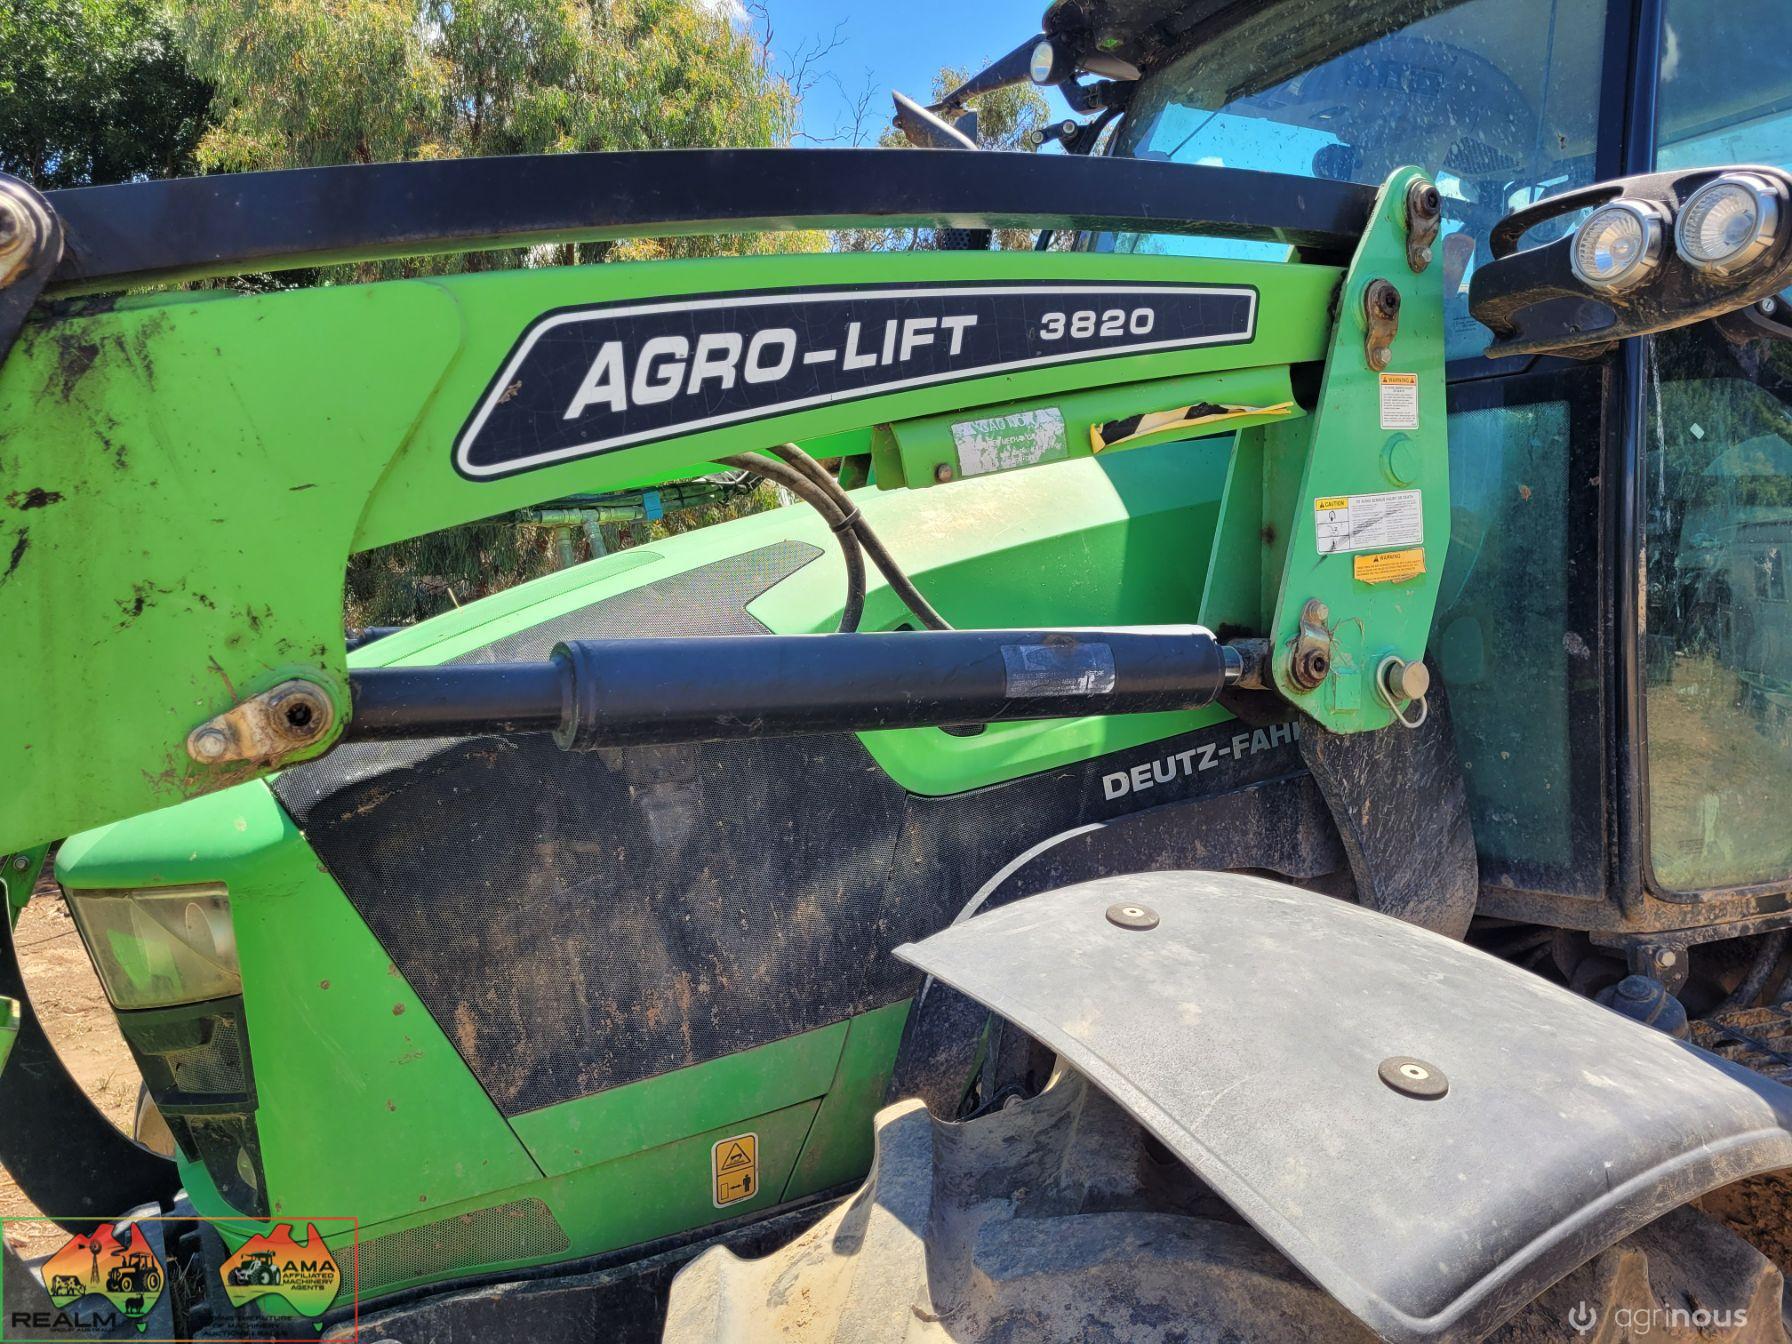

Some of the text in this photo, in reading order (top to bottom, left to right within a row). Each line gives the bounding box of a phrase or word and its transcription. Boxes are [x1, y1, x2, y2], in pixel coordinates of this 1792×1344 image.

[563, 308, 1155, 420] AGRO-LIFT 3820
[1379, 553, 1401, 561] WARNING
